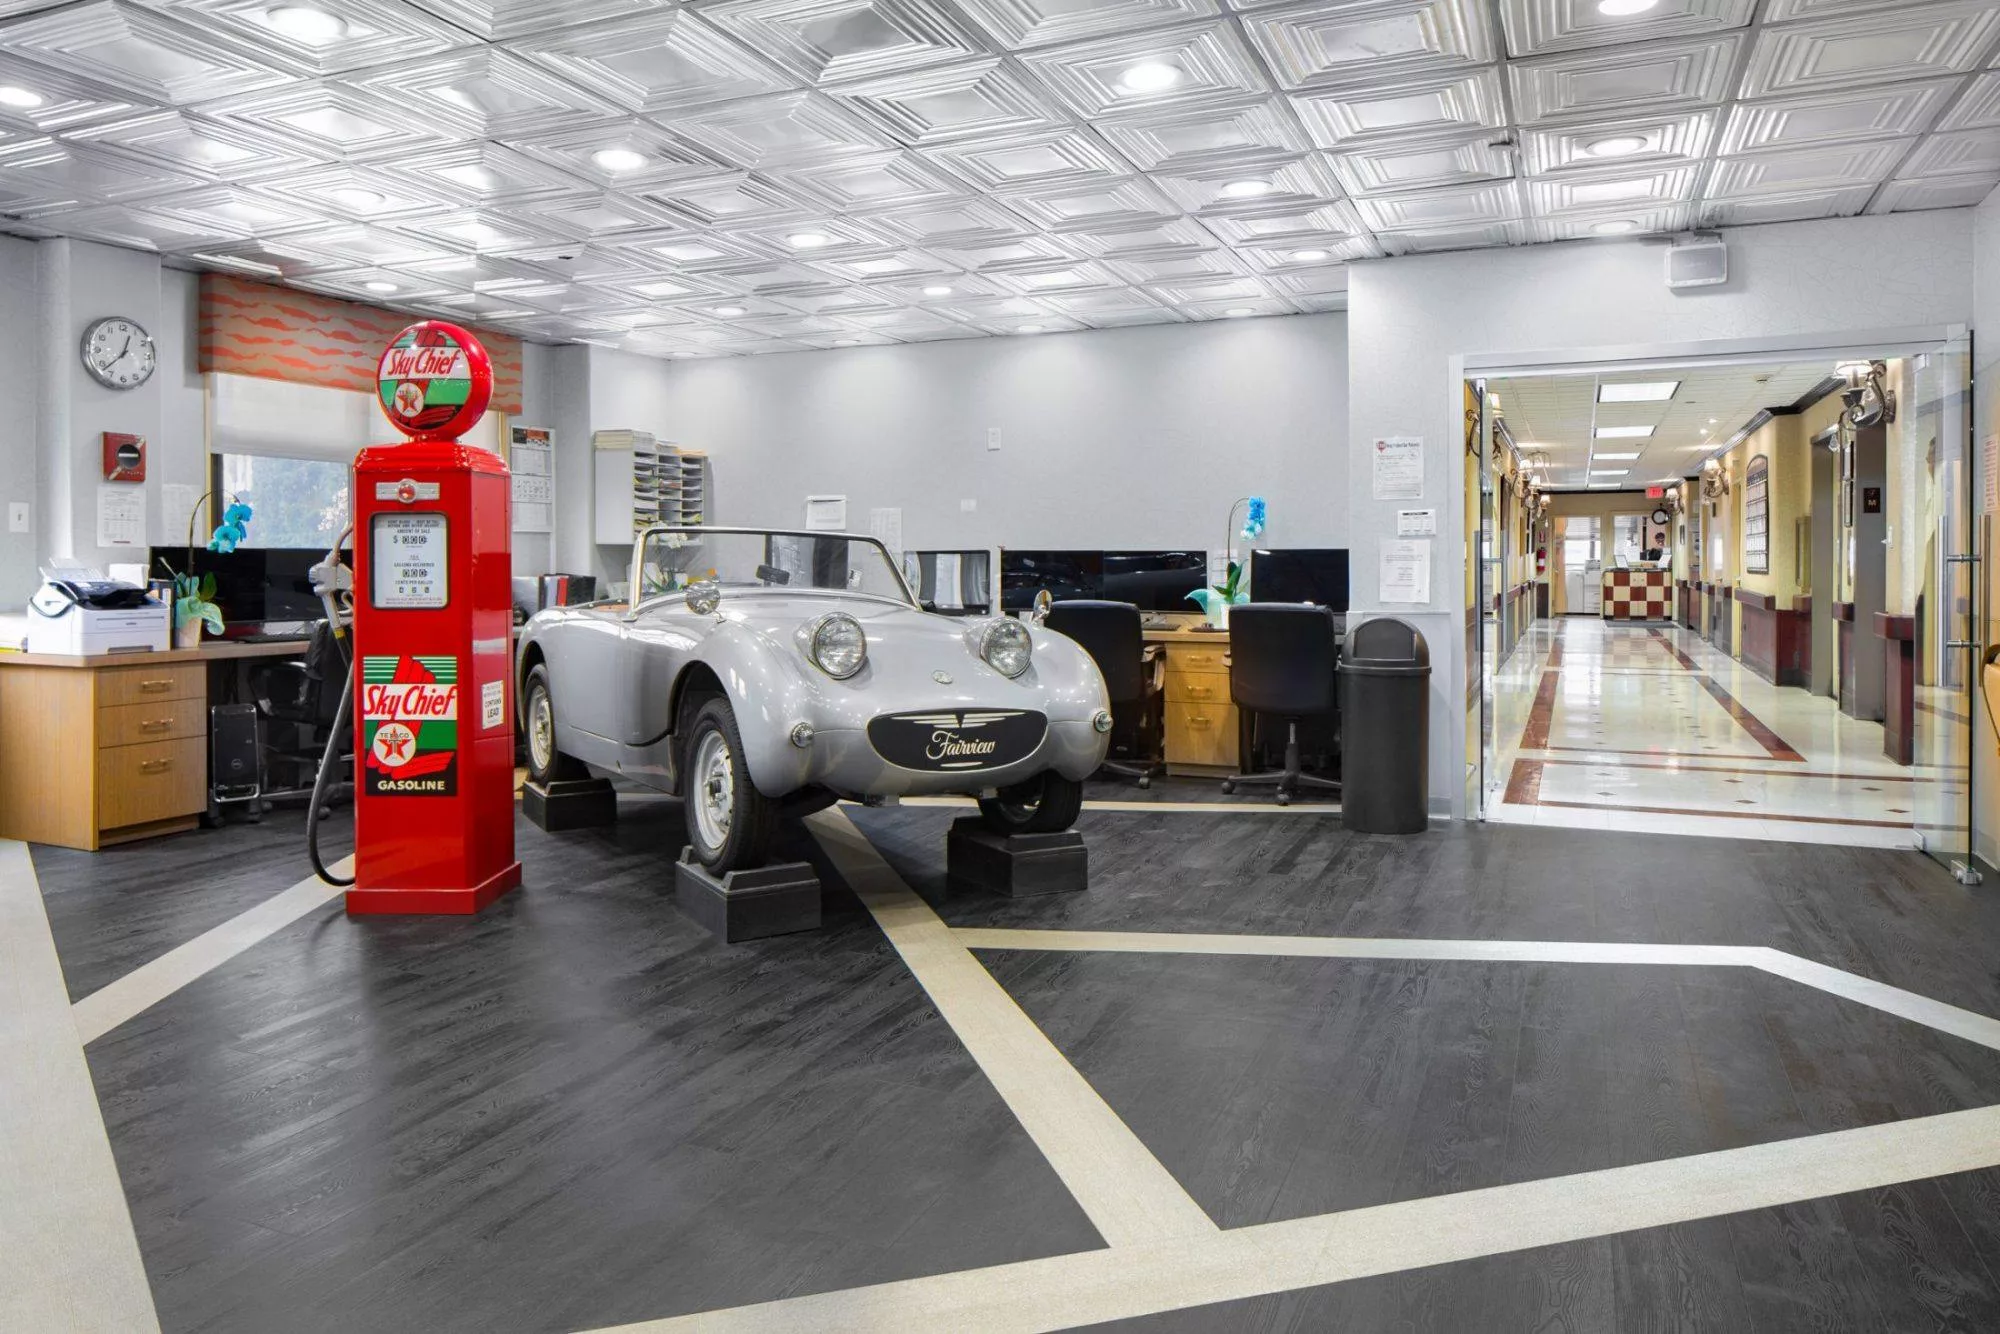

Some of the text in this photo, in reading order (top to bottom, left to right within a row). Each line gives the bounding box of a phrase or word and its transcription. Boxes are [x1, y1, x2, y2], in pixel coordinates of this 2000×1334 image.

[388, 348, 461, 378] Sky Chief
[363, 685, 457, 720] Sky Chief
[487, 708, 500, 719] LEAD
[380, 732, 410, 740] TEXACO
[925, 730, 996, 760] Fairview
[378, 780, 445, 791] GASOLINE
